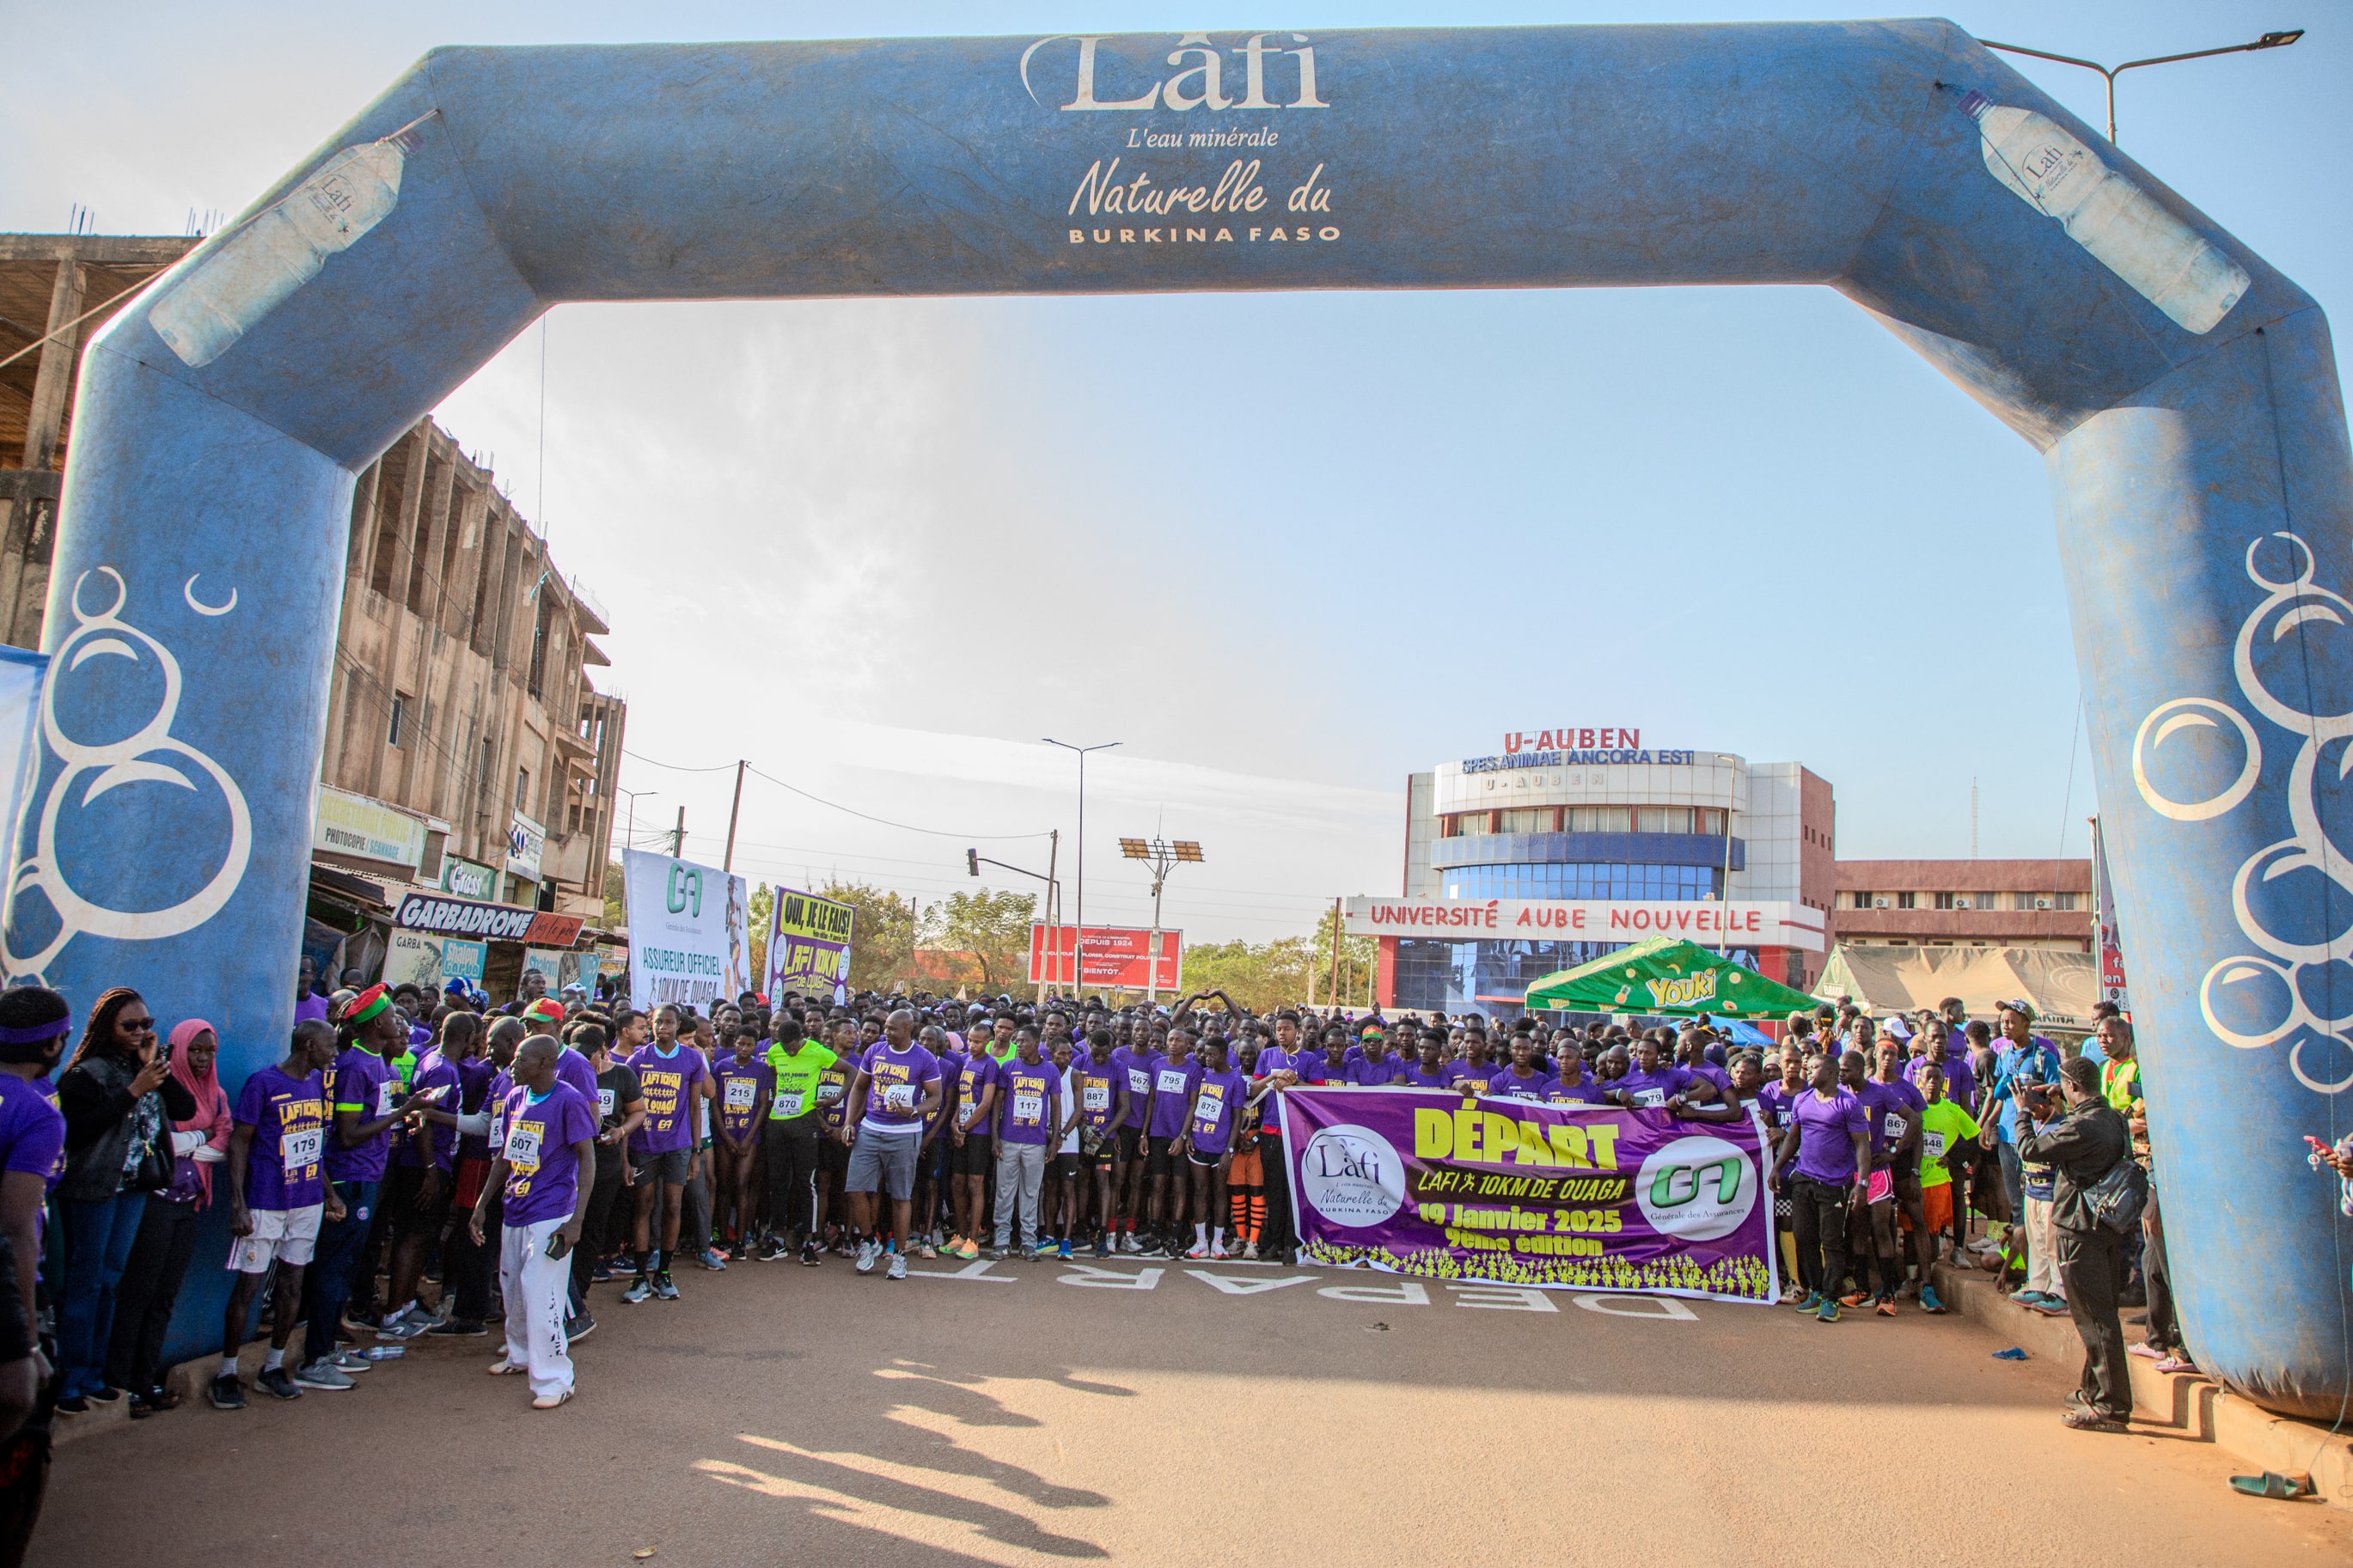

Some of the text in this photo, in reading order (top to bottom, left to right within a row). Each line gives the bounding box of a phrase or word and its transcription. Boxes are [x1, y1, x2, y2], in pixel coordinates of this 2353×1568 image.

[1127, 127, 1279, 148] L'eau minérale
[1067, 157, 1330, 215] Naturelle du
[1069, 226, 1341, 244] BURKINA FASO
[1505, 728, 1640, 753] U-AUBEN
[1462, 749, 1694, 774] SPES ANIMAE ANCORA EST
[325, 827, 366, 851] PHOTOCOPIE
[370, 839, 400, 860] SCANNAGE
[402, 898, 535, 938] GARBADROME
[785, 895, 851, 936] OUI, JE LE FAIS!
[1371, 900, 1761, 932] UNIVERSITÉ AUBE NOUVELLE
[396, 936, 421, 950] GARBA
[447, 942, 479, 965] Shalom
[643, 947, 685, 973] ASSUREUR
[688, 953, 721, 976] OFFICIEL
[785, 943, 814, 975] LAFI
[814, 948, 840, 980] 10KM
[657, 978, 717, 1004] 10KM DE OUAGA
[797, 973, 805, 988] de
[1131, 1075, 1148, 1085] 467
[1164, 1076, 1181, 1085] 795
[730, 1088, 750, 1097] 215
[1647, 1094, 1662, 1102] 79
[779, 1100, 797, 1108] 870
[1019, 1101, 1037, 1110] 117
[1201, 1101, 1217, 1113] 875
[1415, 1098, 1620, 1170] DÉPART
[1886, 1119, 1907, 1129] 867
[293, 1138, 316, 1154] 179
[511, 1137, 532, 1152] 607
[1418, 1171, 1627, 1201] LAFI 10KM DE OUAGA
[1320, 1188, 1388, 1207] Naturelle du
[1418, 1203, 1623, 1233] 19 Janvier 2025
[1650, 1211, 1685, 1220] Générale
[1702, 1208, 1745, 1218] Assurances
[1515, 1234, 1603, 1257] édition
